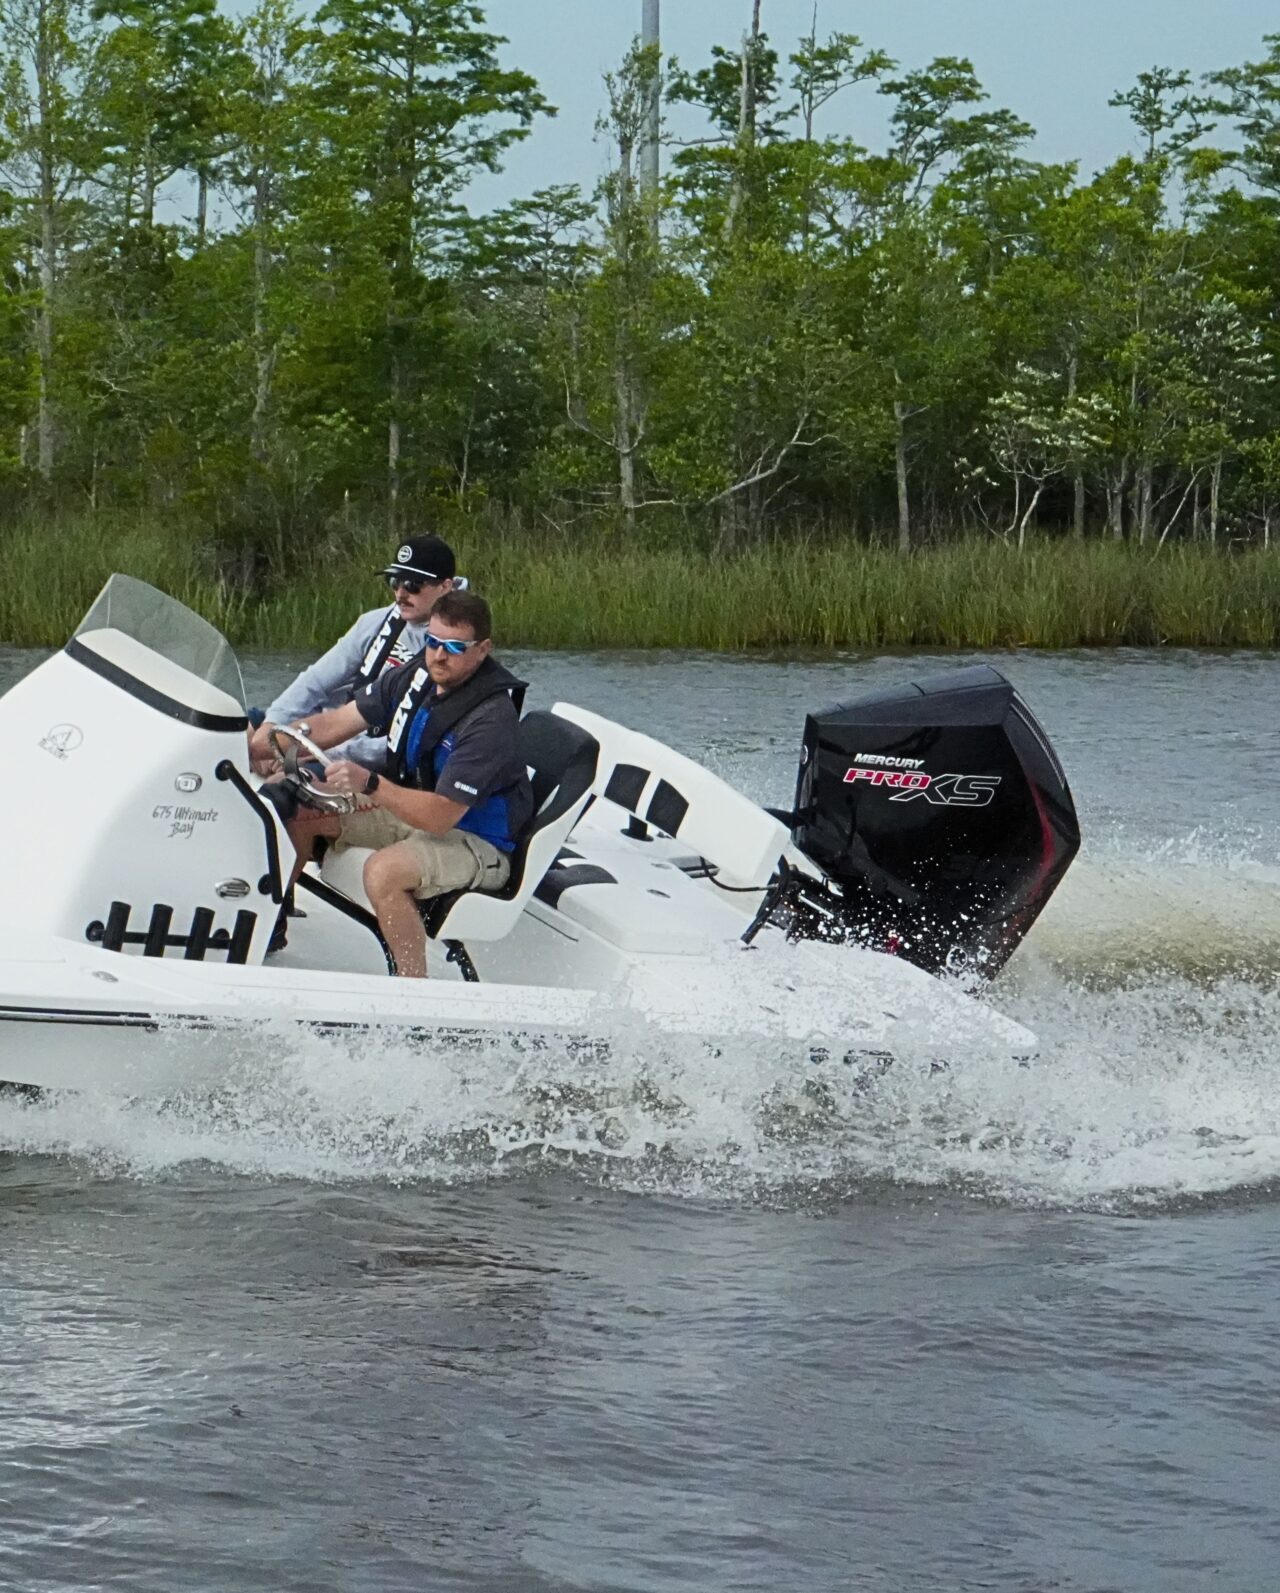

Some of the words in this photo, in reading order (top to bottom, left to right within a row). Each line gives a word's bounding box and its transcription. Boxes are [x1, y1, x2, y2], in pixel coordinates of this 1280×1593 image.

[387, 667, 428, 753] BLAZER
[854, 753, 925, 769] MERCURY
[843, 768, 932, 789] PRO
[152, 805, 174, 818] 675
[174, 807, 219, 822] Ultimate
[168, 821, 195, 840] Bay
